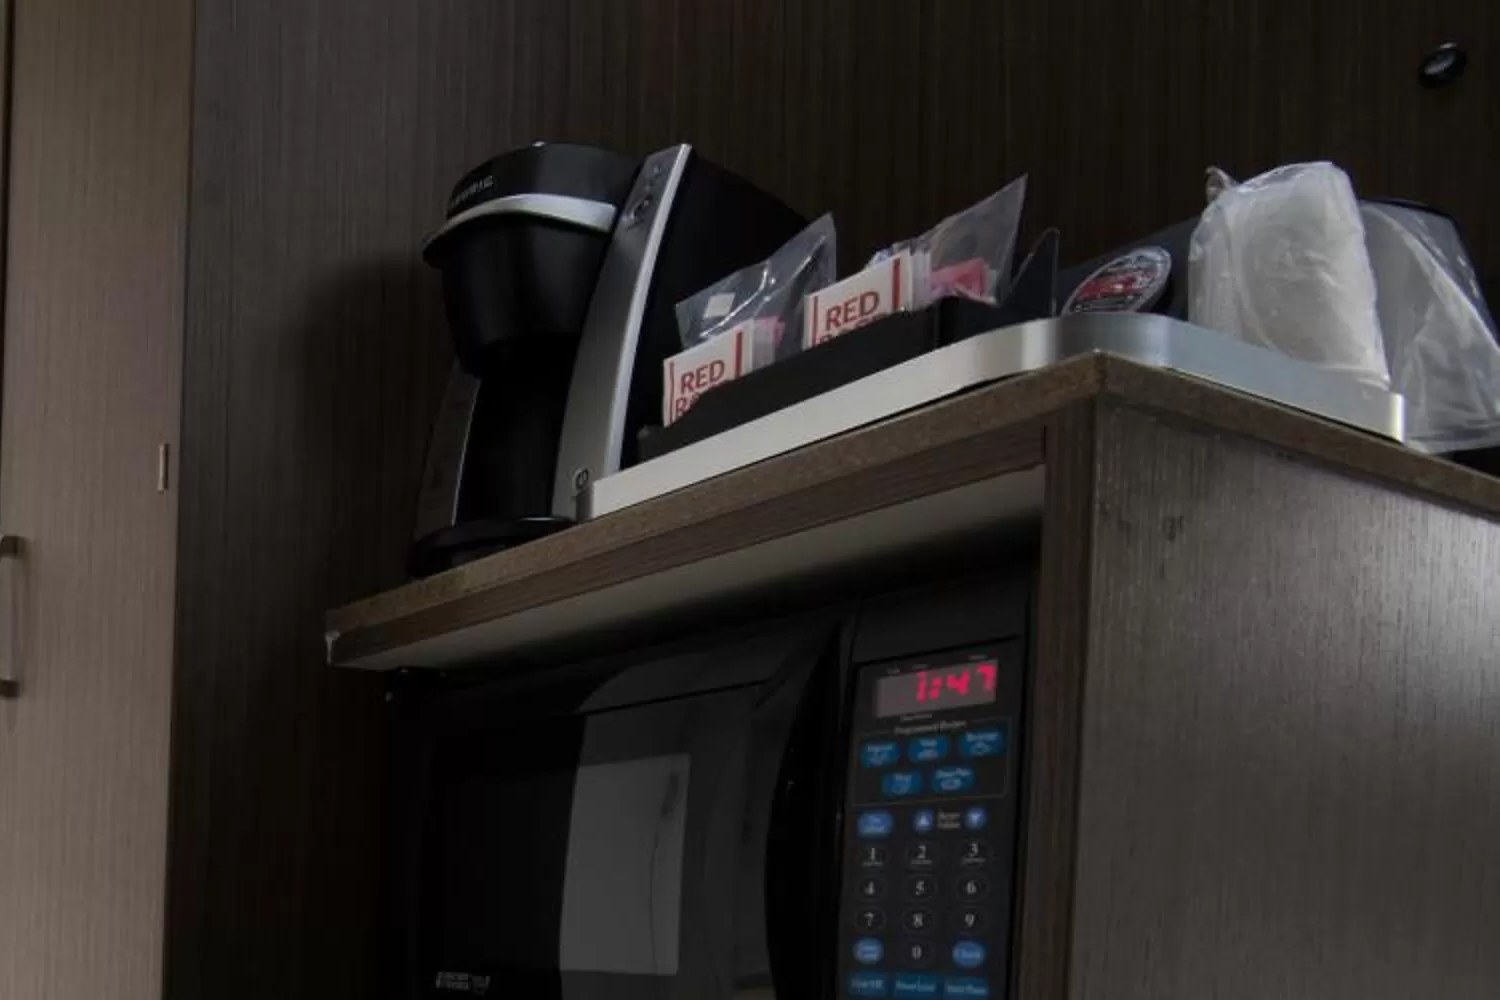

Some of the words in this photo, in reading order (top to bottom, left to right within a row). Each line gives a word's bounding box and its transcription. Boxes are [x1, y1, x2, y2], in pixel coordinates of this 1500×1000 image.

[826, 291, 879, 331] RED
[681, 359, 725, 394] RED
[916, 662, 997, 703] 1:47
